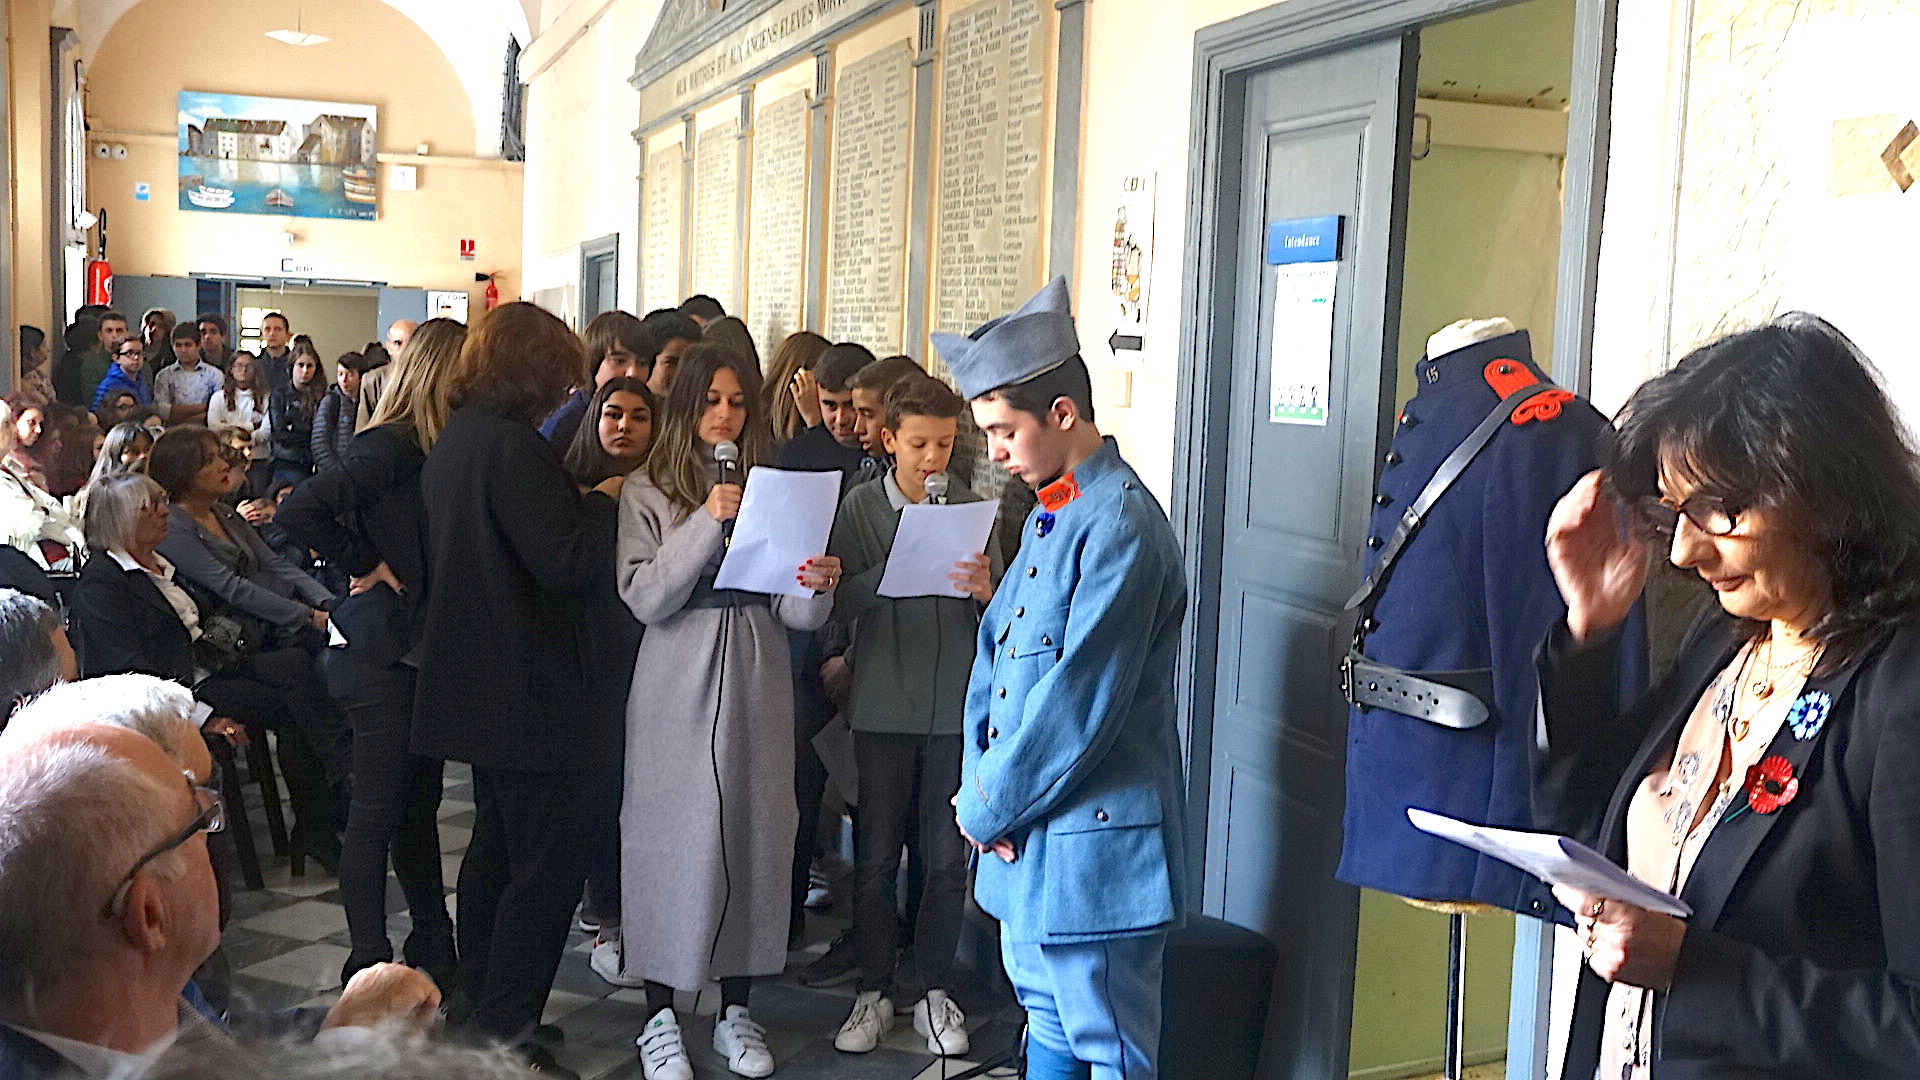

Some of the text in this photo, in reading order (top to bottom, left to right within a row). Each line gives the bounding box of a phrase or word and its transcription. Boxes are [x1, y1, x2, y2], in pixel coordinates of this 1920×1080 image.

[717, 53, 727, 75] ET
[730, 43, 743, 66] AUX
[745, 23, 778, 58] ANCIENS
[780, 2, 814, 39] ELEVES
[1284, 233, 1320, 249] Intendance
[1426, 364, 1439, 385] 15
